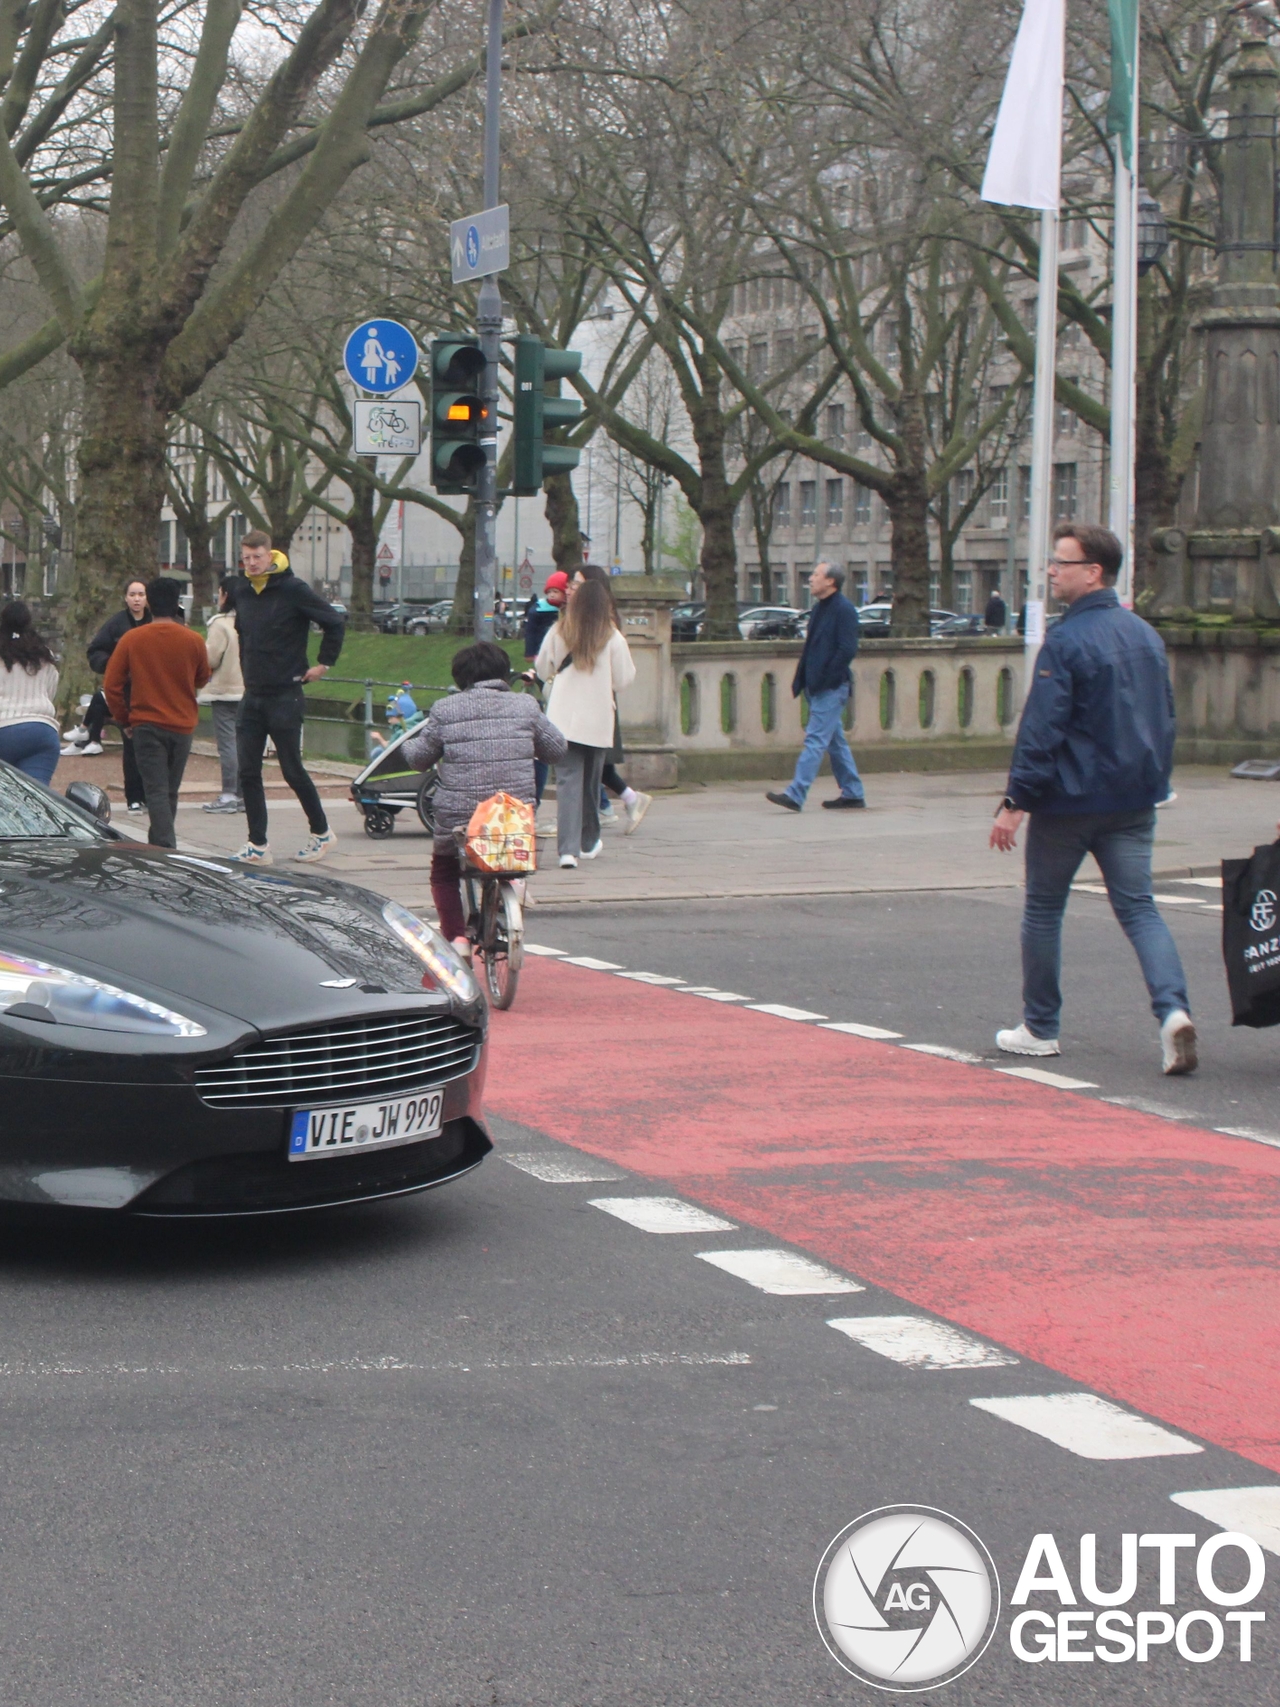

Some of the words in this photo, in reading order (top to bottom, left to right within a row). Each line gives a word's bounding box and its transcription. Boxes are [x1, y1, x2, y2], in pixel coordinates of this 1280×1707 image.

[311, 1110, 356, 1147] VIE
[372, 1103, 401, 1138] JW
[405, 1095, 440, 1133] 999
